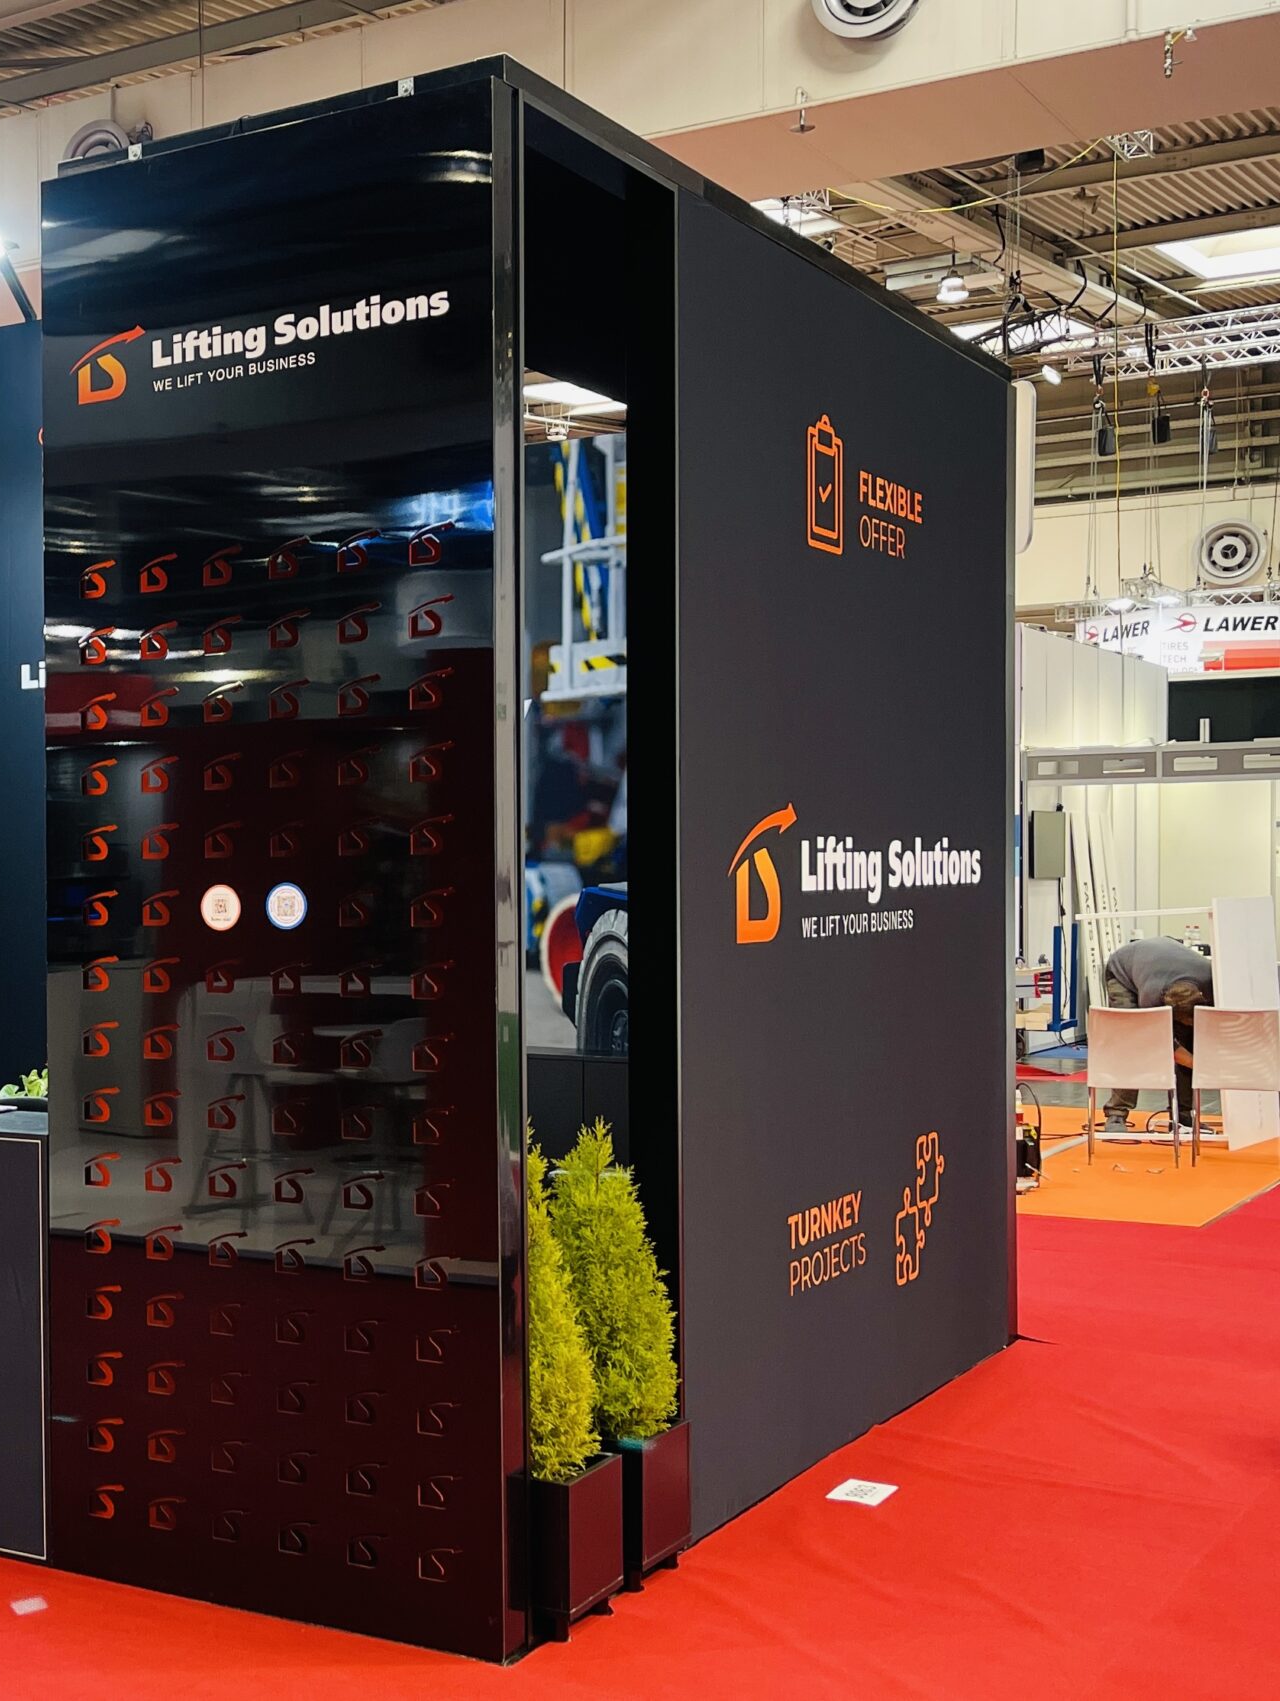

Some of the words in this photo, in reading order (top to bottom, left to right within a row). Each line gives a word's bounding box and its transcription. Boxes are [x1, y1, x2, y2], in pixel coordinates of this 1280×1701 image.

[151, 325, 267, 369] Lifting
[273, 291, 450, 345] Solutions
[153, 378, 173, 392] WE
[176, 372, 204, 388] LIFT
[207, 364, 244, 383] YOUR
[249, 352, 316, 376] BUSINESS
[859, 470, 923, 524] FLEXIBLE
[859, 515, 906, 560] OFFER
[1102, 620, 1151, 643] LAWER
[1203, 615, 1280, 633] LAWER
[801, 835, 883, 904] Lifting
[888, 836, 982, 888] Solutions
[801, 916, 818, 939] WE
[819, 914, 840, 937] LIFT
[842, 912, 869, 935] YOUR
[870, 908, 914, 932] BUSINESS
[787, 1190, 863, 1250] TURNKEY
[789, 1232, 866, 1297] PROJECTS
